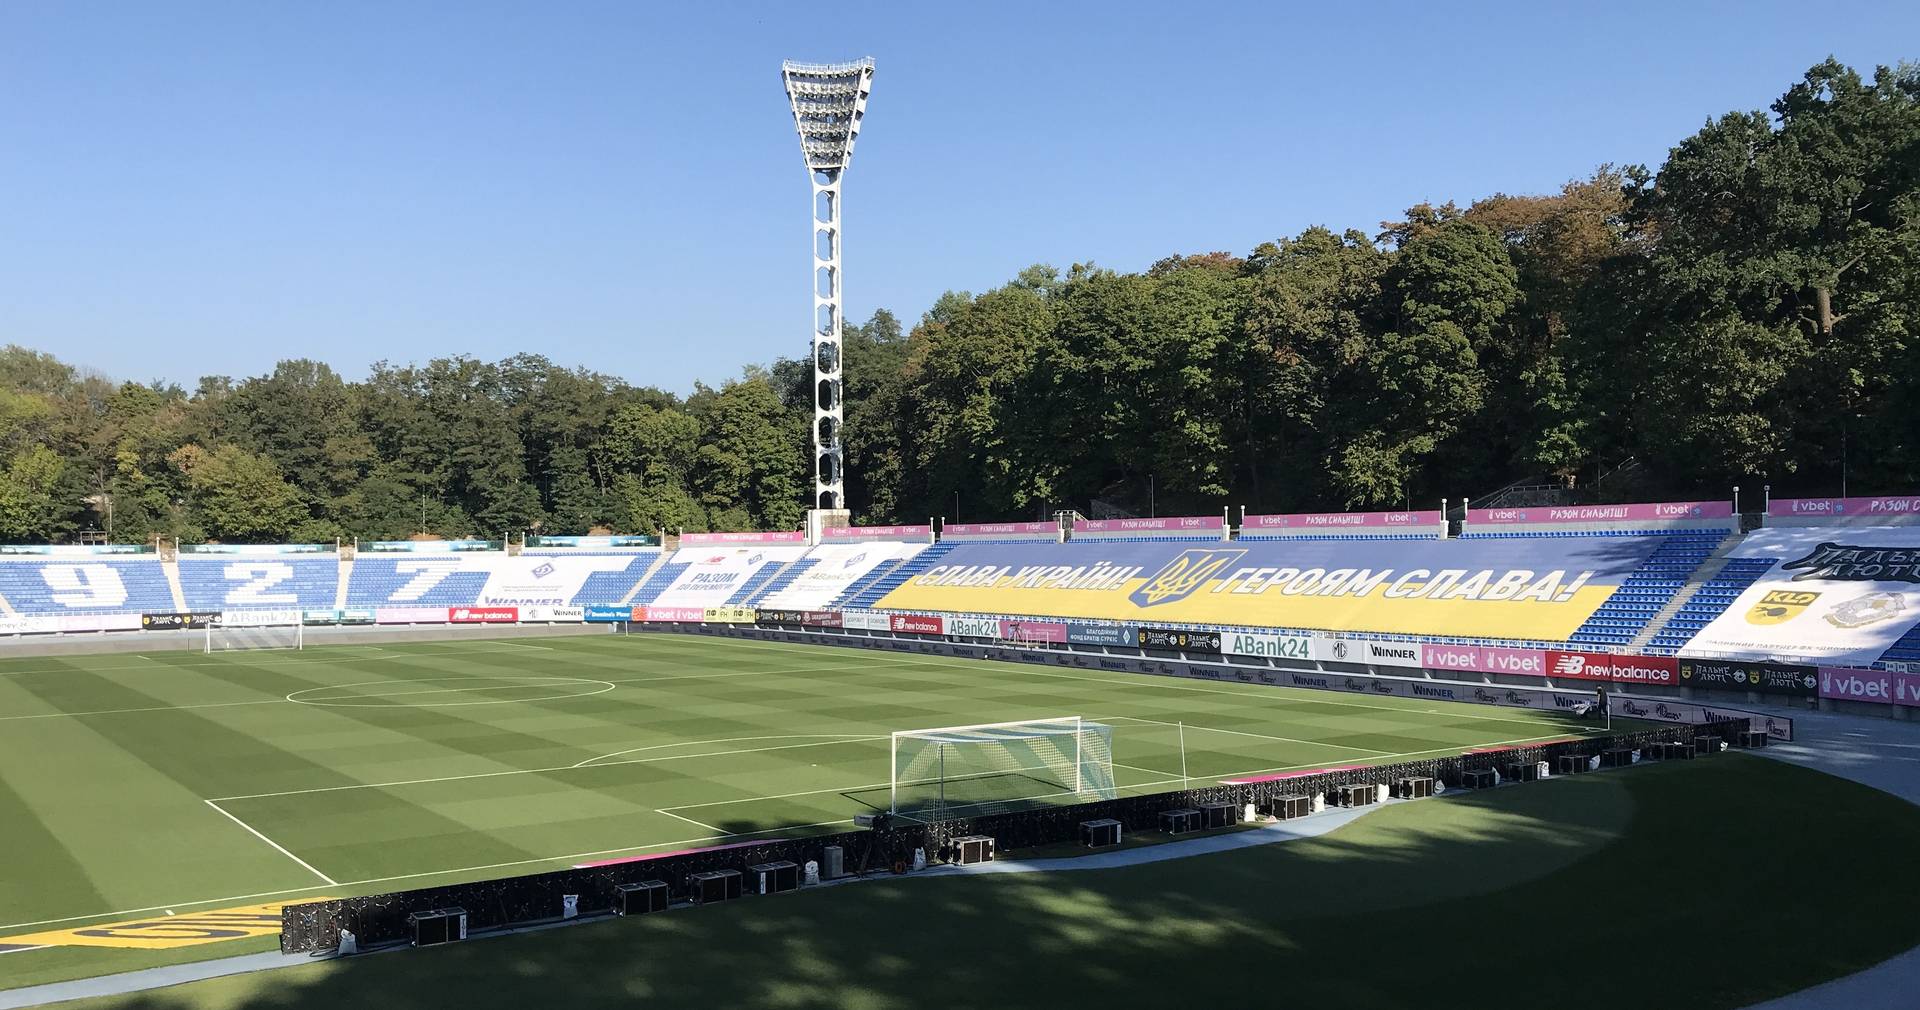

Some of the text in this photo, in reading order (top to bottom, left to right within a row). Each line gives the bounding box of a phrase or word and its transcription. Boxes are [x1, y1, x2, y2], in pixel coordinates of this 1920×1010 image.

[1663, 504, 1689, 515] vbet
[1801, 500, 1830, 511] vbet
[1264, 516, 1281, 524] vbet
[1390, 514, 1409, 523] vbet
[1495, 510, 1517, 520] vbet
[223, 562, 298, 604] 2
[388, 560, 464, 602] 7
[690, 572, 740, 583] РАЗОМ
[914, 561, 1144, 591] СЛАВА УКРАЇНІ!
[40, 563, 129, 608] 9
[1212, 567, 1595, 602] ГЕРОЯМ СЛАВА!
[230, 611, 298, 624] ABank24
[484, 611, 512, 619] balance
[654, 609, 675, 619] vbet
[682, 609, 703, 620] vbet
[904, 622, 915, 631] new
[915, 622, 938, 632] balance
[950, 619, 998, 637] ABank24
[1232, 635, 1310, 659] ABank24
[1370, 644, 1417, 661] WINNER
[1100, 658, 1128, 671] WINNER
[1437, 651, 1477, 668] vbet
[1498, 654, 1541, 672] vbet
[1189, 665, 1221, 680] WINNER
[1585, 663, 1612, 678] new
[1612, 665, 1671, 682] balance
[1696, 664, 1732, 677] ПАЛЬНЕ
[1764, 669, 1802, 683] ПАЛЬНЕ
[1292, 674, 1328, 689] WINNER
[1700, 672, 1727, 684] ЛЮТІ
[1768, 678, 1797, 689] ЛЮТІ
[1411, 682, 1456, 700] WINNER
[1836, 676, 1889, 698] vbet
